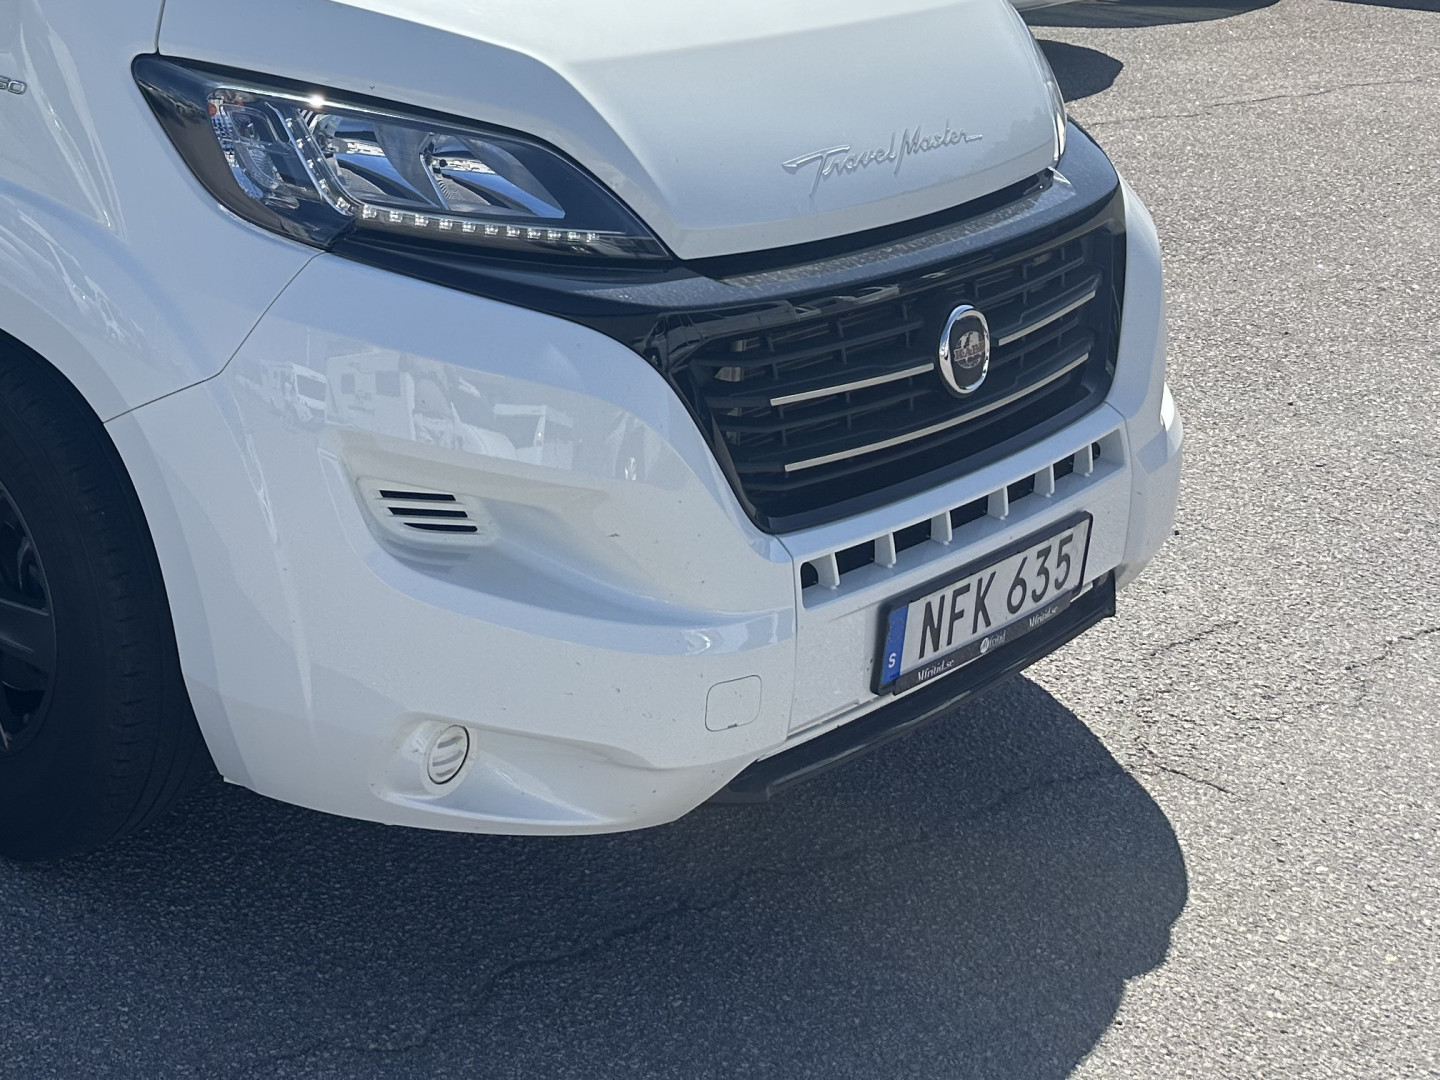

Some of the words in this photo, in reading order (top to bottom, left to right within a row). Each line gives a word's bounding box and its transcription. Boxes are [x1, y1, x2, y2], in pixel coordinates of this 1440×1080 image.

[919, 571, 997, 659] NFK
[1006, 534, 1074, 614] 635
[888, 652, 897, 668] S
